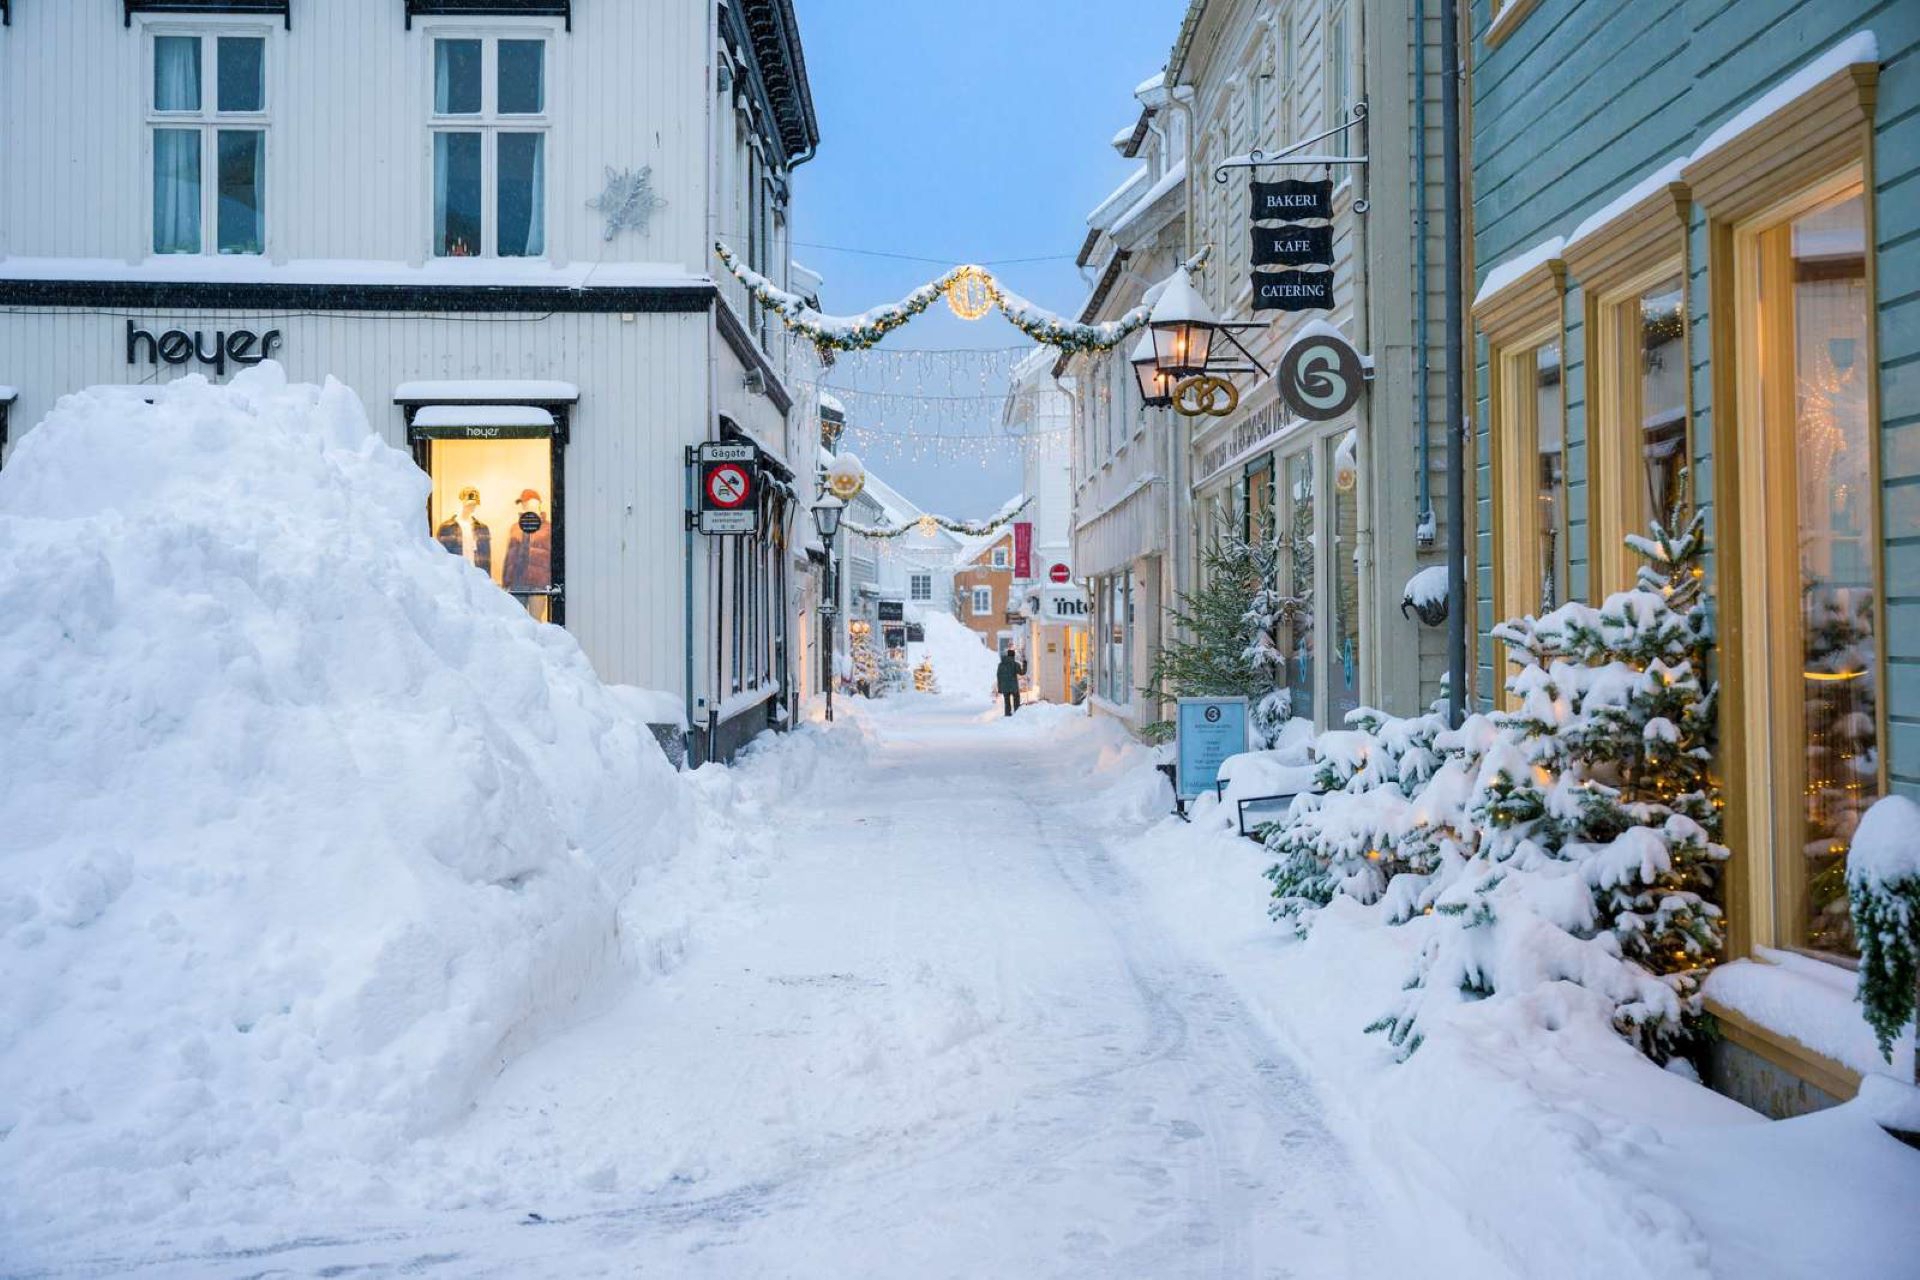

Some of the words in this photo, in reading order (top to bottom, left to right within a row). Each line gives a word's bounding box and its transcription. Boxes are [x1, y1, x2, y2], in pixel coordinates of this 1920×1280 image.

[1267, 194, 1318, 207] BAKERI
[1274, 240, 1311, 252] KAFE
[1261, 284, 1325, 297] CATERING
